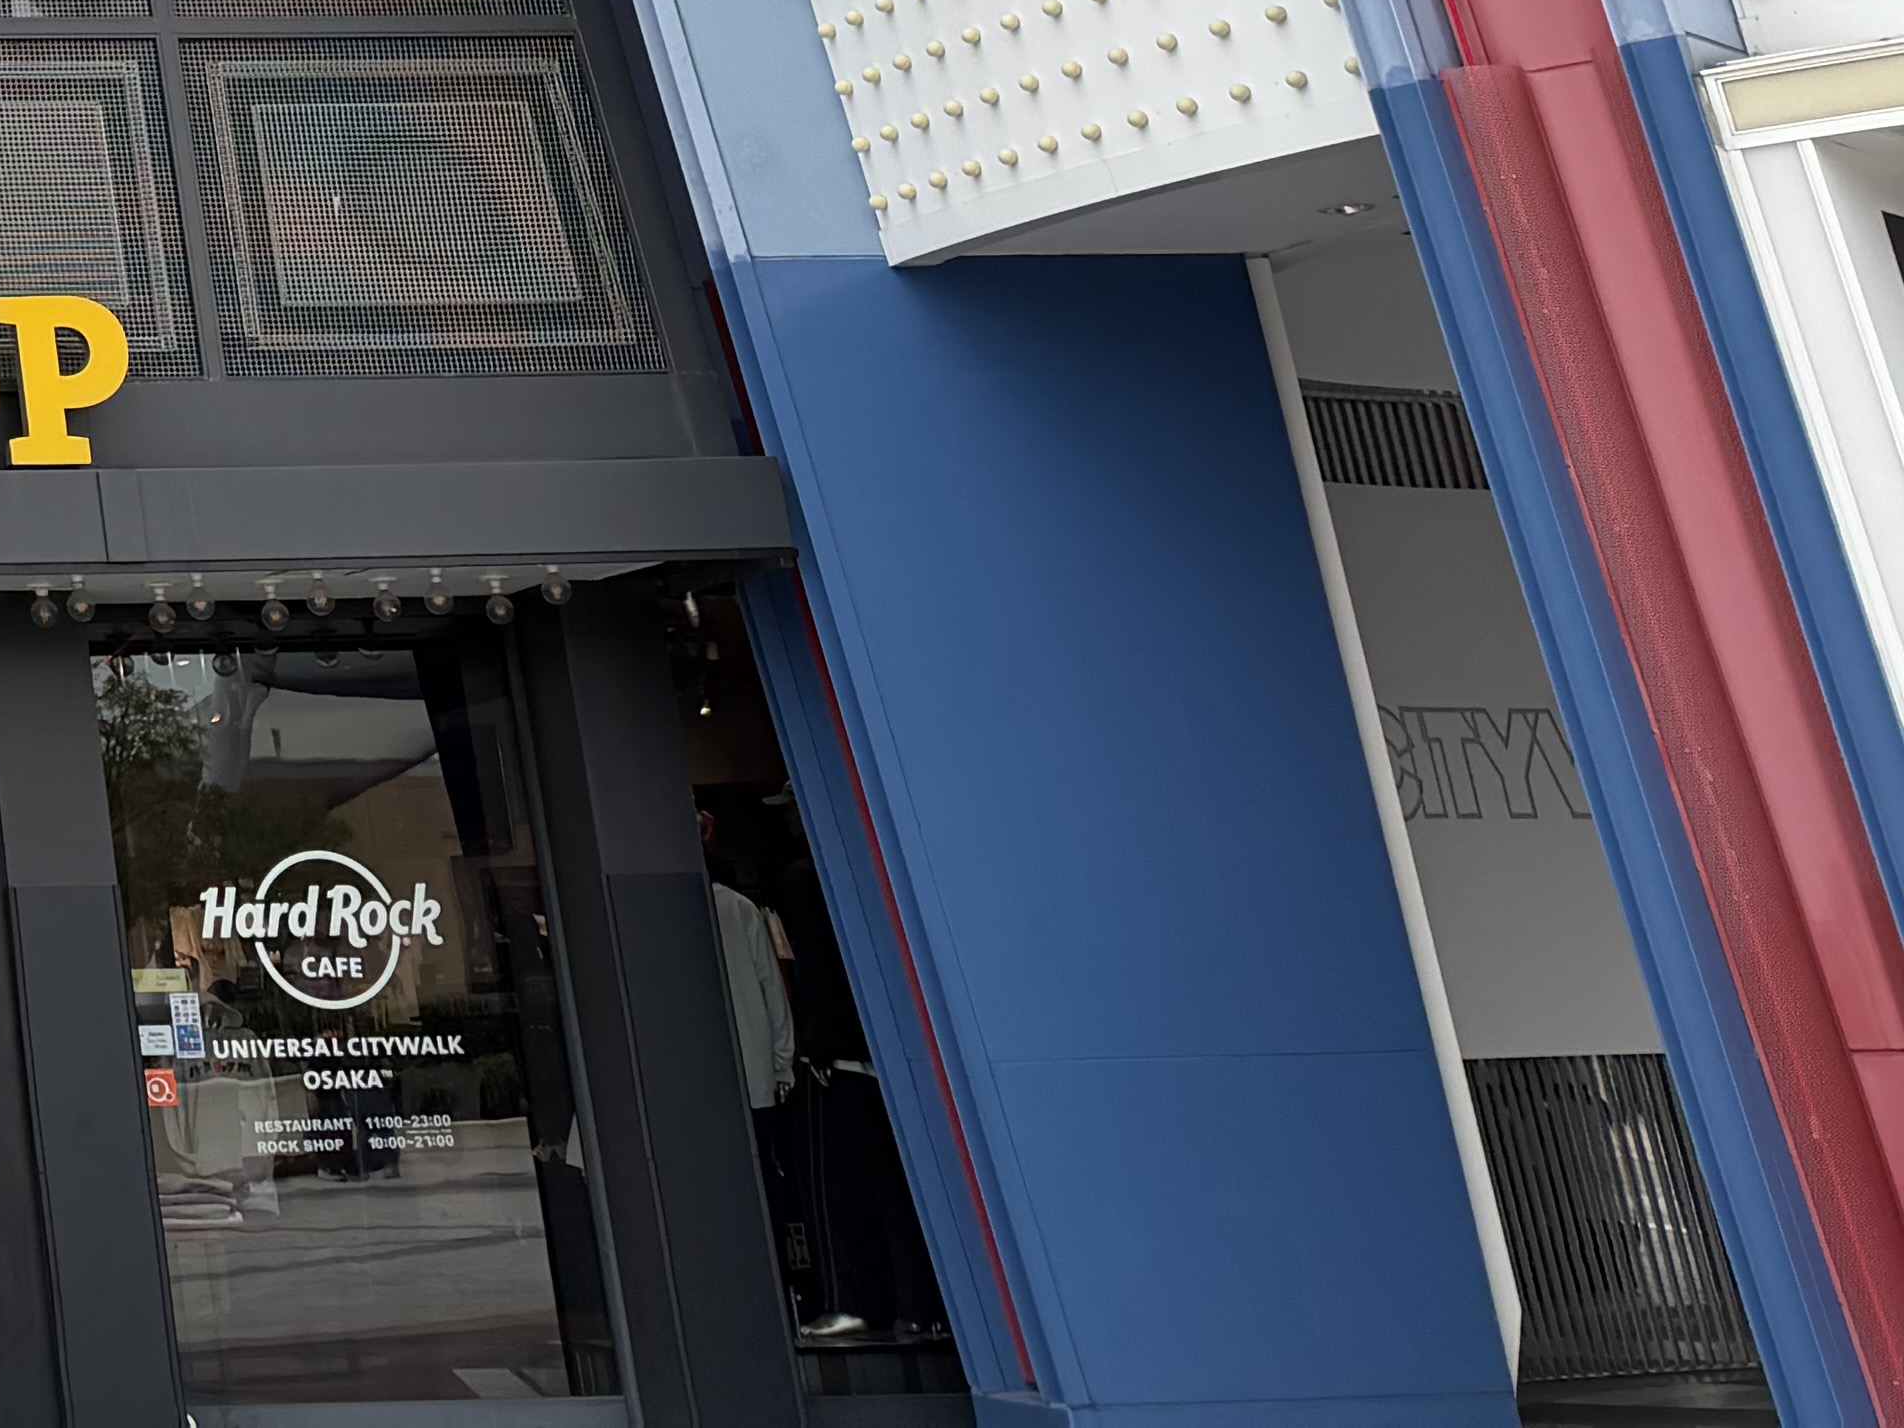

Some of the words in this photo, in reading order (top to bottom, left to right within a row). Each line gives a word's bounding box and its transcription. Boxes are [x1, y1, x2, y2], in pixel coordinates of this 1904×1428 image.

[200, 885, 320, 939] Hard
[327, 883, 444, 948] Rock
[301, 956, 364, 978] CAFE
[212, 1037, 344, 1059] UNIVERSAL
[347, 1035, 465, 1055] CITYWALK
[254, 1118, 353, 1134] RESTAURANT
[257, 1140, 299, 1154] ROCK
[303, 1138, 345, 1153] SHOP
